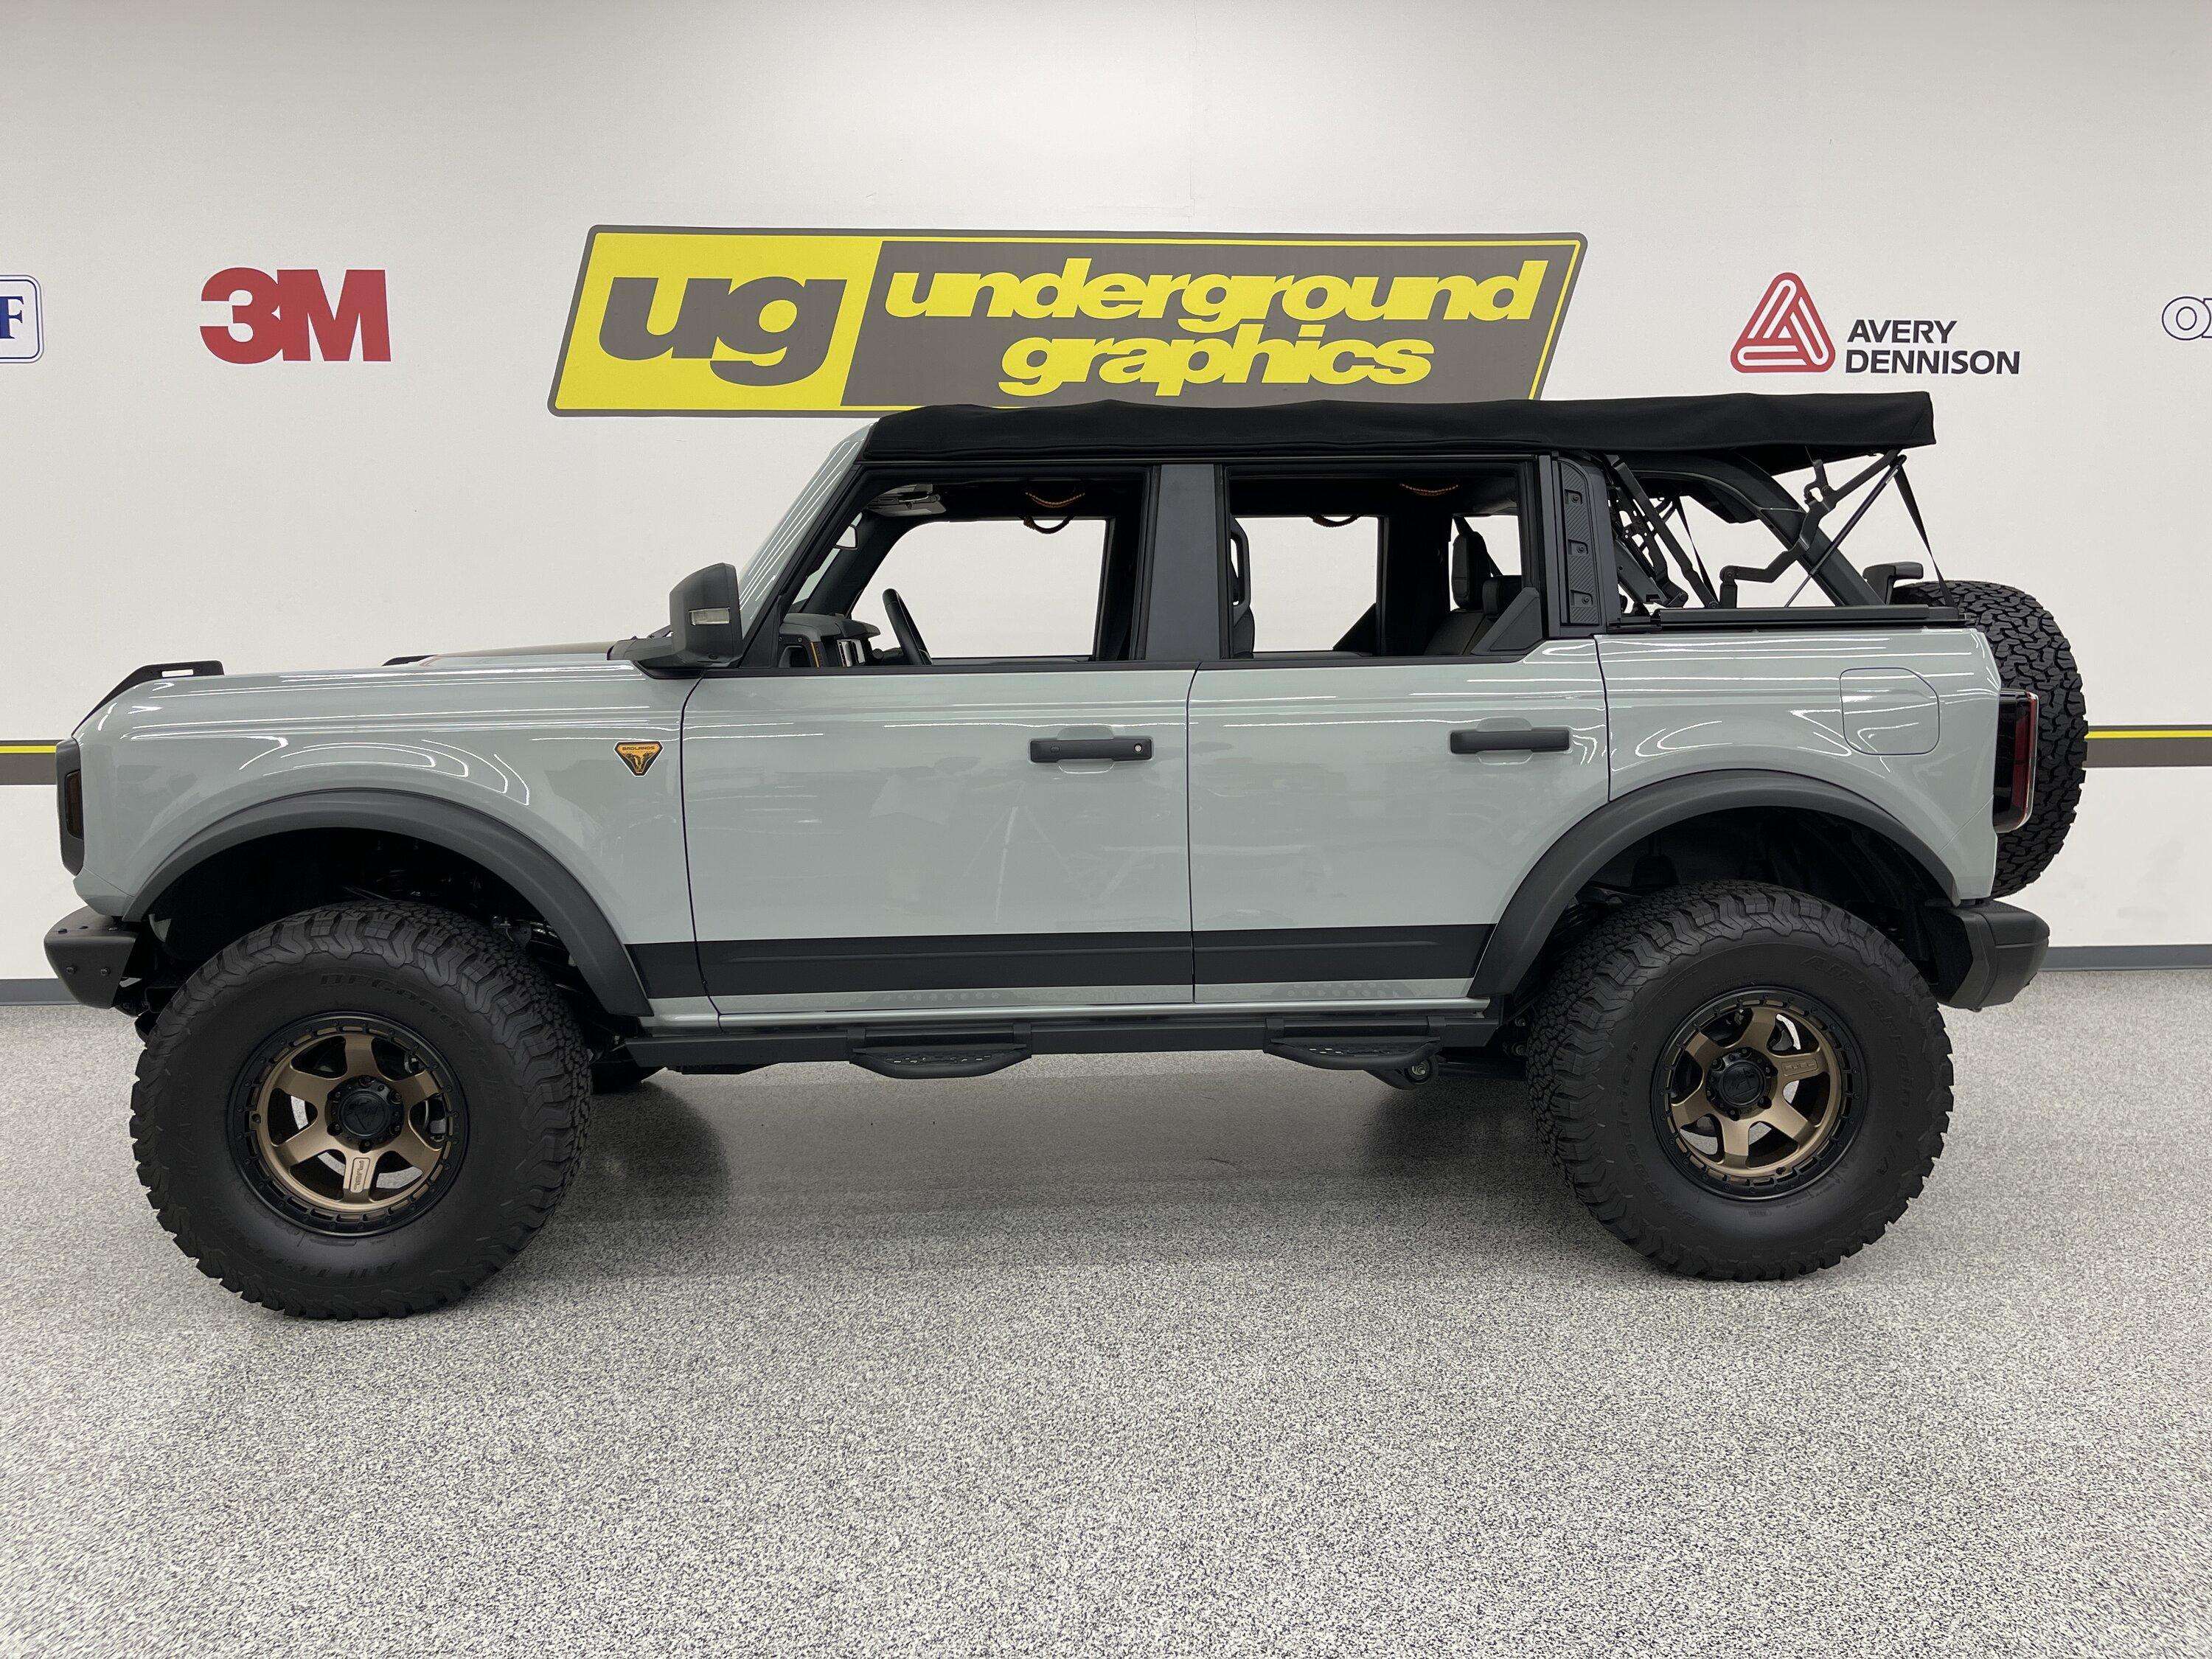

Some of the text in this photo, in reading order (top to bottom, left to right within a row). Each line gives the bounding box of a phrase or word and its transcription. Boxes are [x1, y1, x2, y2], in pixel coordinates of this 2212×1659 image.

[201, 268, 391, 364] 3M
[599, 276, 847, 386] ug
[886, 258, 1547, 334] underground
[1847, 319, 1958, 344] AVERY
[998, 323, 1435, 397] graphics
[1845, 349, 2020, 375] DENNISON
